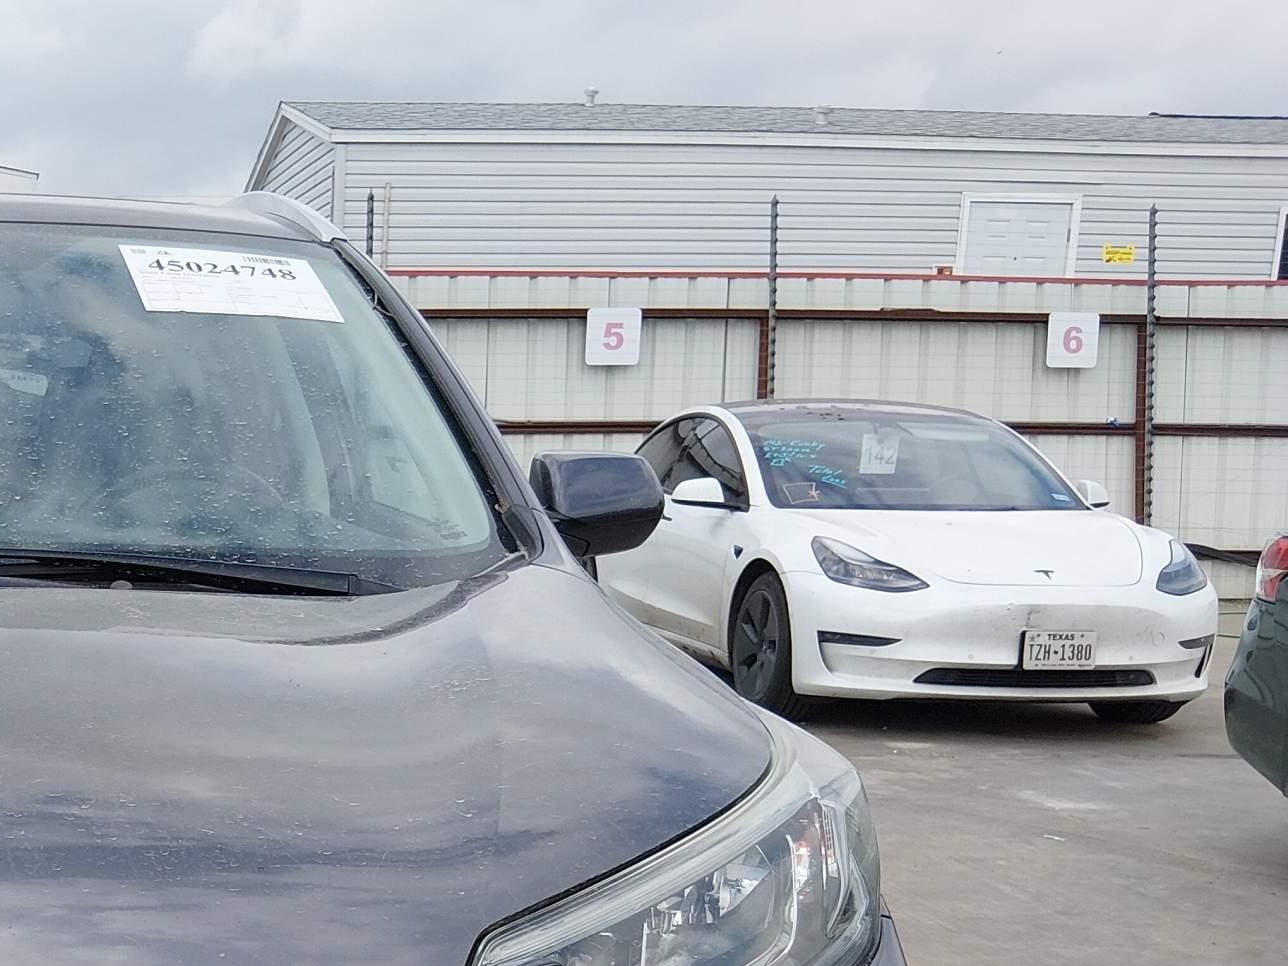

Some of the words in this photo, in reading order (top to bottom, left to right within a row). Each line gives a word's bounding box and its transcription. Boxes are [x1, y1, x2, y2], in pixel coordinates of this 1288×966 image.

[148, 258, 297, 281] 45024748
[602, 322, 624, 351] 5
[1063, 326, 1083, 354] 6
[866, 447, 895, 465] 142
[1047, 633, 1076, 641] TEXAS
